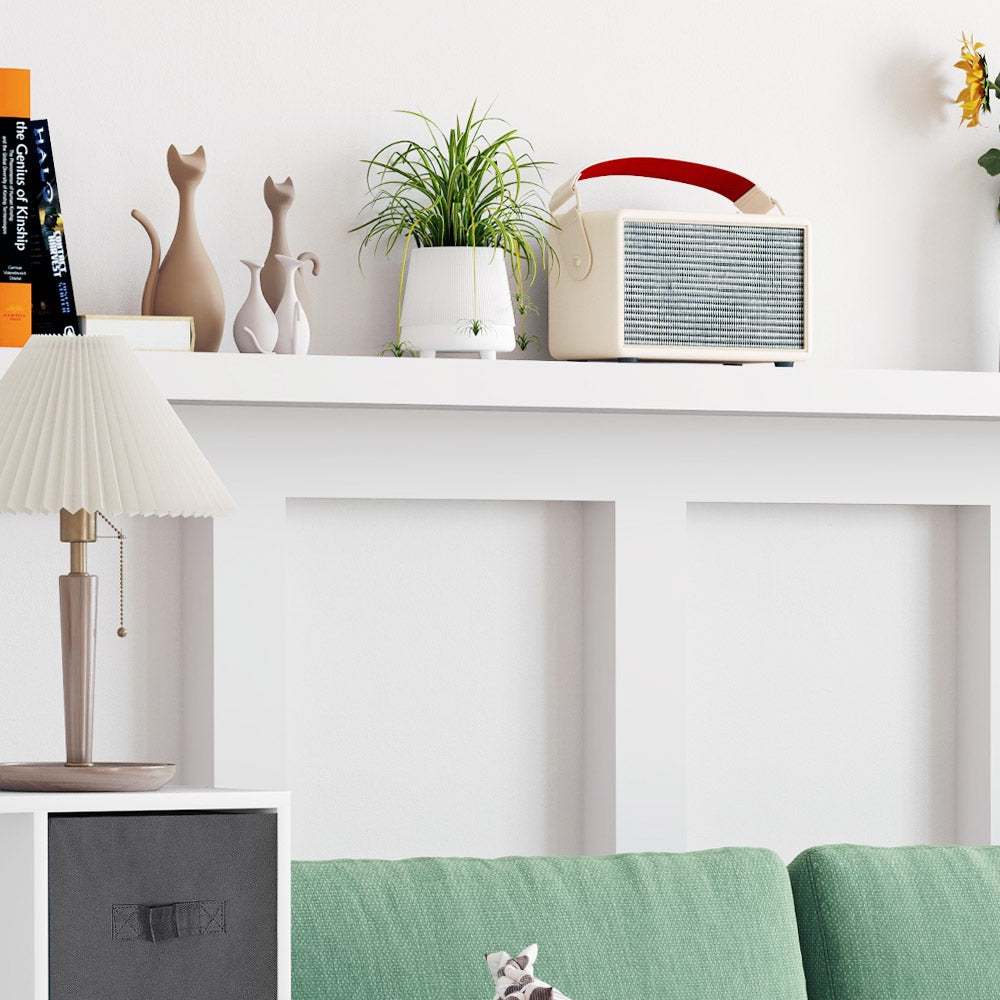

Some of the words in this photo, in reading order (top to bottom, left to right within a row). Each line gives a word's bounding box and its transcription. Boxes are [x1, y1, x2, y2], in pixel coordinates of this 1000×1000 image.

[16, 121, 28, 140] the
[16, 144, 28, 186] Genius
[33, 126, 54, 204] HALO
[16, 188, 28, 203] of
[14, 206, 29, 251] Kinship
[48, 236, 62, 278] HARVEST
[52, 230, 67, 273] CONTACT
